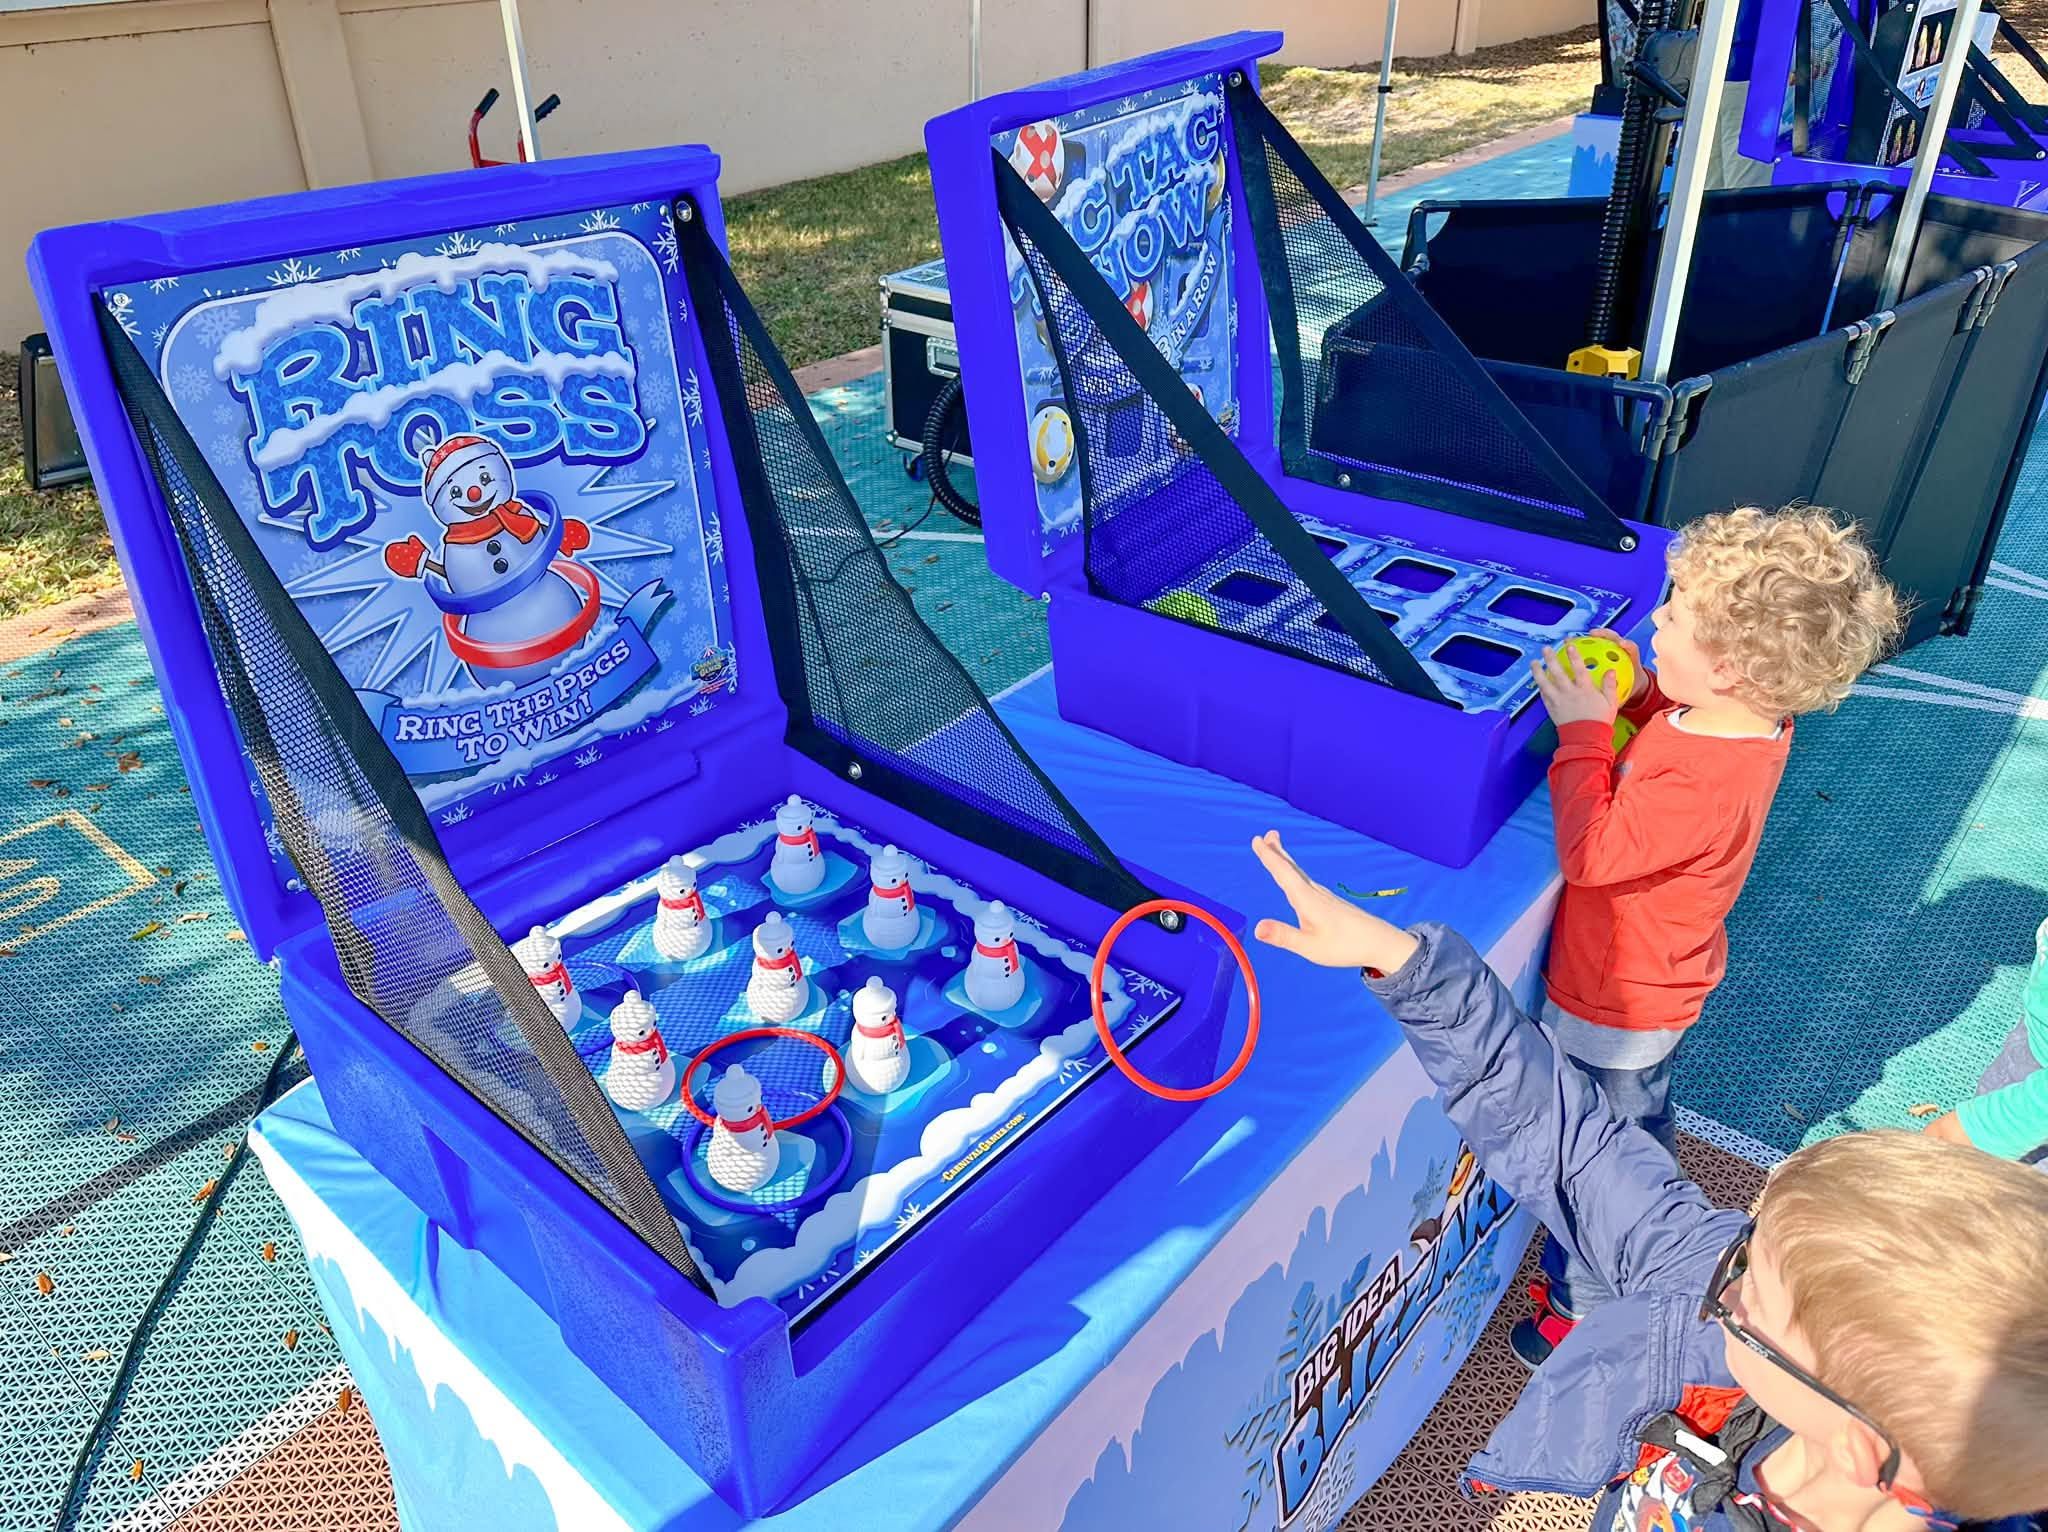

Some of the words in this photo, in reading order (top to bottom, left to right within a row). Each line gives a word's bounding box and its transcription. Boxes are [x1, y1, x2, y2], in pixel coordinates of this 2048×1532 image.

[1108, 105, 1219, 210] TAC
[232, 270, 636, 446] RING
[1171, 322, 1187, 349] IN
[1185, 308, 1196, 326] A
[1192, 251, 1216, 309] ROW
[258, 370, 650, 546] TOSS
[395, 711, 482, 741] RING
[486, 688, 553, 727] THE
[555, 639, 631, 701] PEGS
[457, 734, 508, 762] TO
[509, 692, 593, 746] WIN!
[1280, 1168, 1515, 1516] BLIZZAR
[1297, 1333, 1339, 1411] BIG
[1343, 1263, 1397, 1349] IDEA
